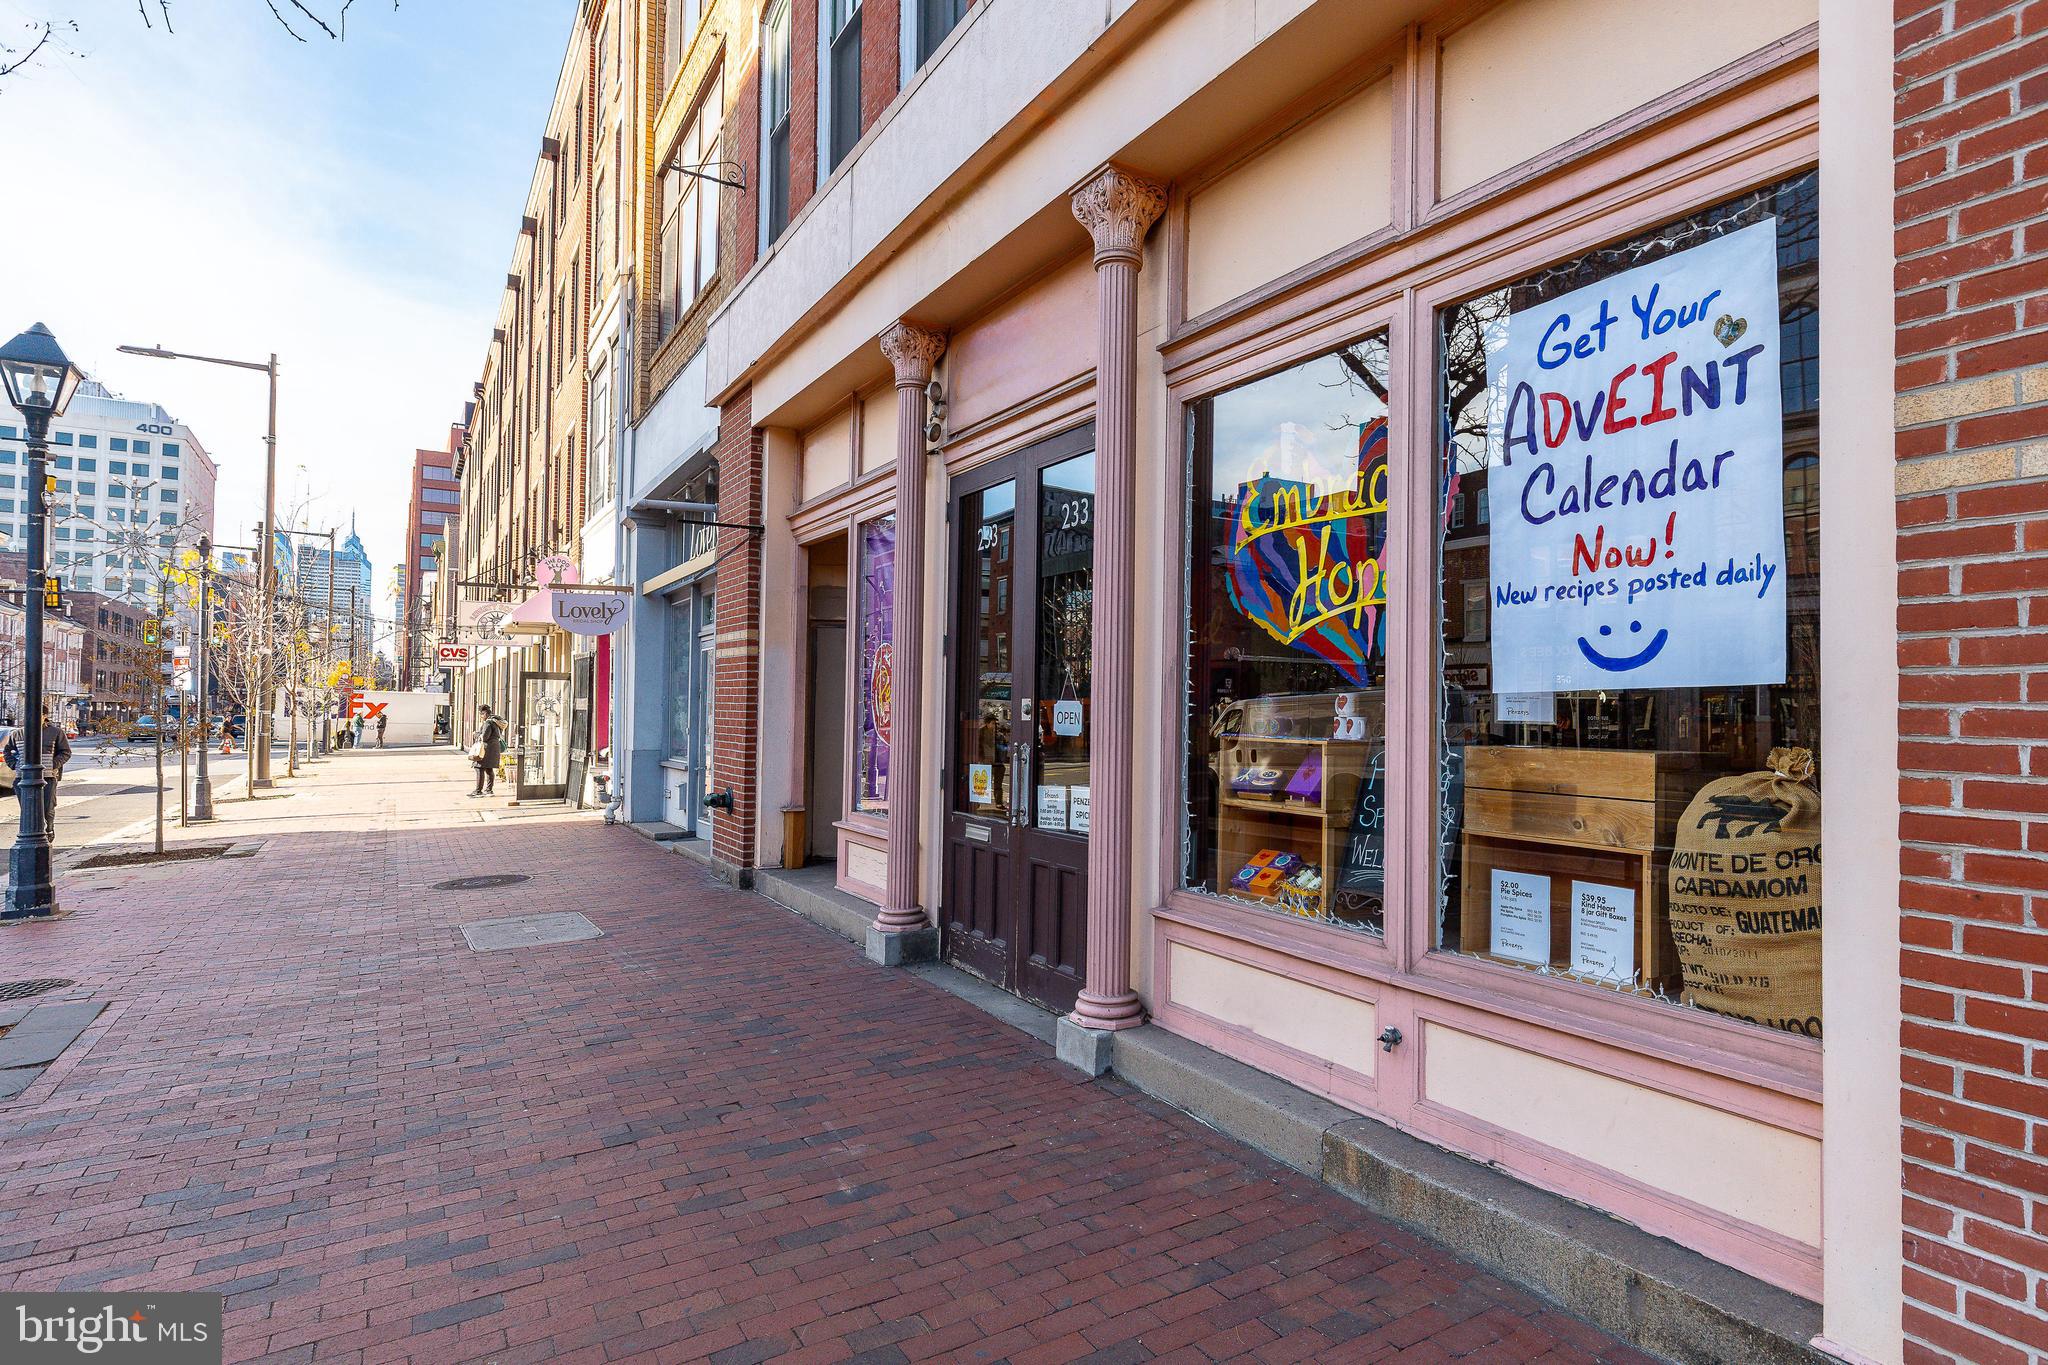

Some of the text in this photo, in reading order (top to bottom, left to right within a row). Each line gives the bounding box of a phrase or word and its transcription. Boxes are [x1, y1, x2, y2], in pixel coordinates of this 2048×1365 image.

[1537, 282, 1722, 370] Get Your
[1503, 343, 1765, 466] ADVEINT
[136, 424, 172, 435] 400
[1520, 438, 1735, 525] Calendar
[1061, 497, 1089, 529] 233
[977, 523, 998, 551] 233
[1572, 511, 1677, 577] Now!
[1288, 525, 1387, 629] Hop
[1496, 552, 1778, 608] New recipes posted daily
[558, 599, 625, 625] Lovely
[440, 647, 468, 657] CVS
[1056, 711, 1080, 726] OPEN
[1670, 851, 1724, 874] MONTE
[1731, 852, 1768, 874] DE
[1500, 880, 1519, 889] $2.00
[1511, 889, 1533, 898] Spices
[1674, 874, 1808, 899] CARDAMOM
[1581, 893, 1606, 905] $39.95
[1581, 901, 1616, 912] Kind Heart
[1586, 908, 1595, 916] jar
[1595, 910, 1608, 918] Gift
[1608, 912, 1627, 921] Boxes
[1709, 906, 1732, 917] DE:
[1715, 924, 1735, 936] OF:
